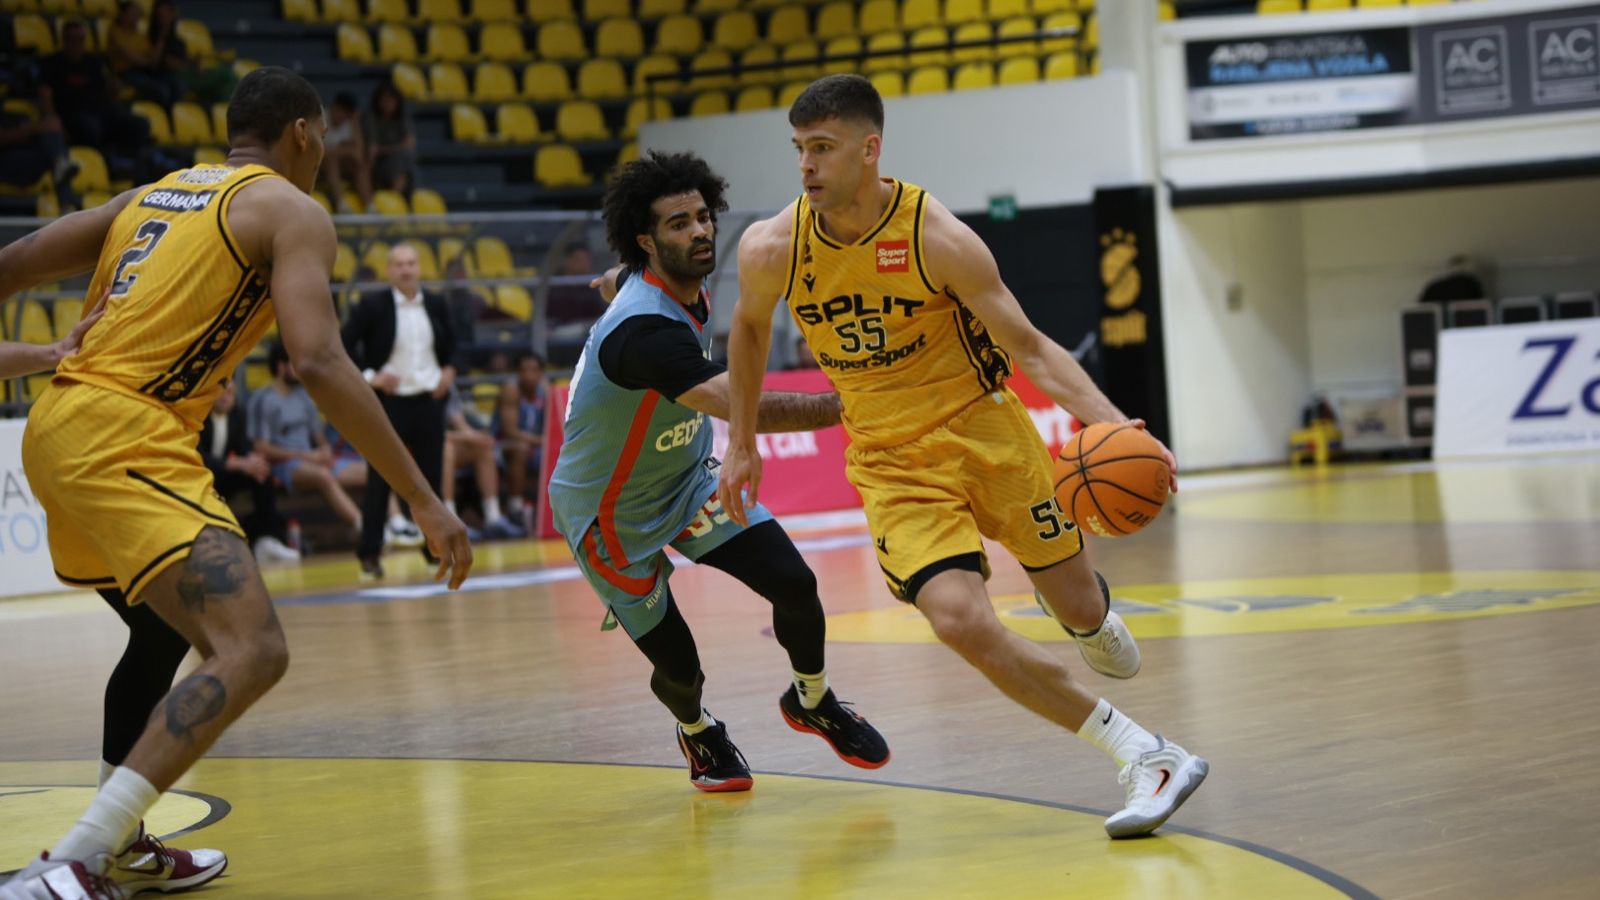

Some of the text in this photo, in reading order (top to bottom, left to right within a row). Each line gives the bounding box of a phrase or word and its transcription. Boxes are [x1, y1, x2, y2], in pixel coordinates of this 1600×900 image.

[1445, 37, 1499, 72] AC
[1541, 27, 1596, 63] AC
[110, 218, 171, 297] 2
[877, 248, 908, 258] Super
[879, 256, 906, 266] Sport
[795, 293, 925, 326] SPLIT
[819, 333, 927, 371] SuperSport
[833, 316, 888, 354] 55
